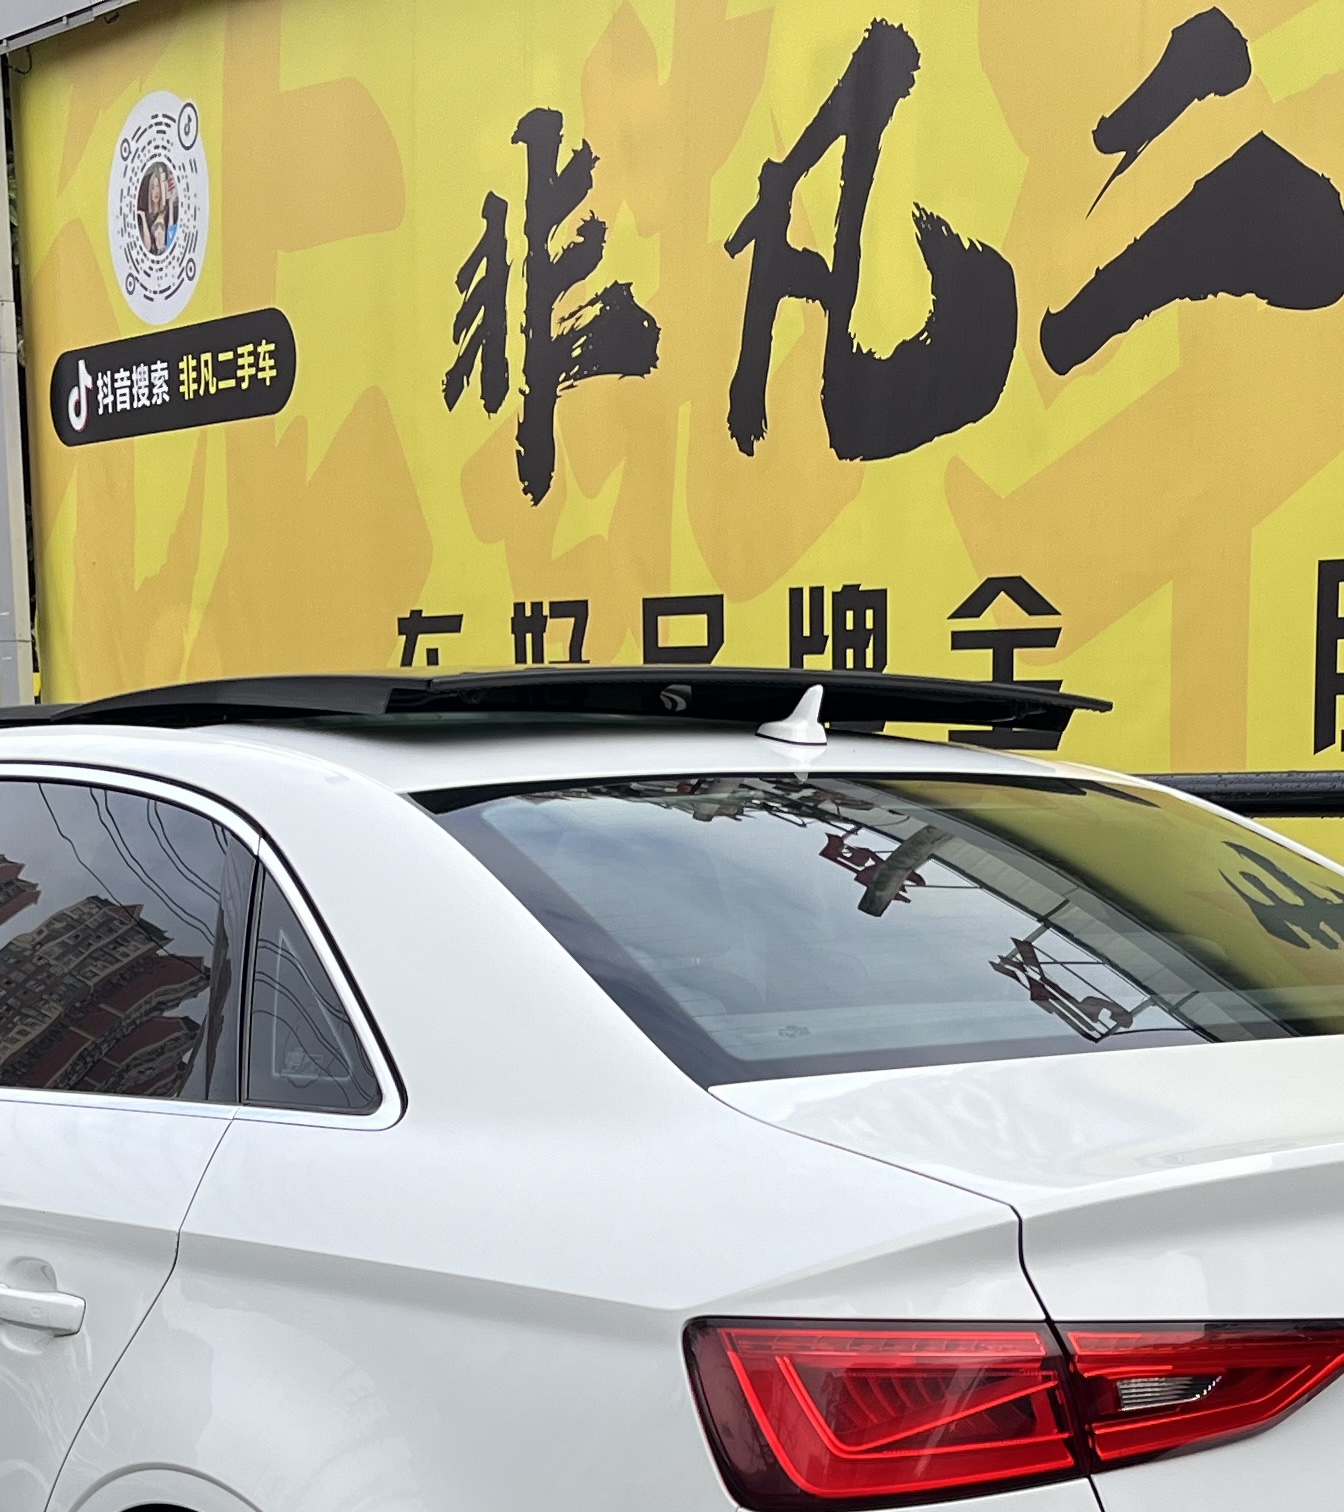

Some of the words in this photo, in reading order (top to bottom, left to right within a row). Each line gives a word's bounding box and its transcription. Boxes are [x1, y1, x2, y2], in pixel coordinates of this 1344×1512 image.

[96, 360, 170, 415] 抖音搜索
[178, 339, 278, 400] 非凡二手车
